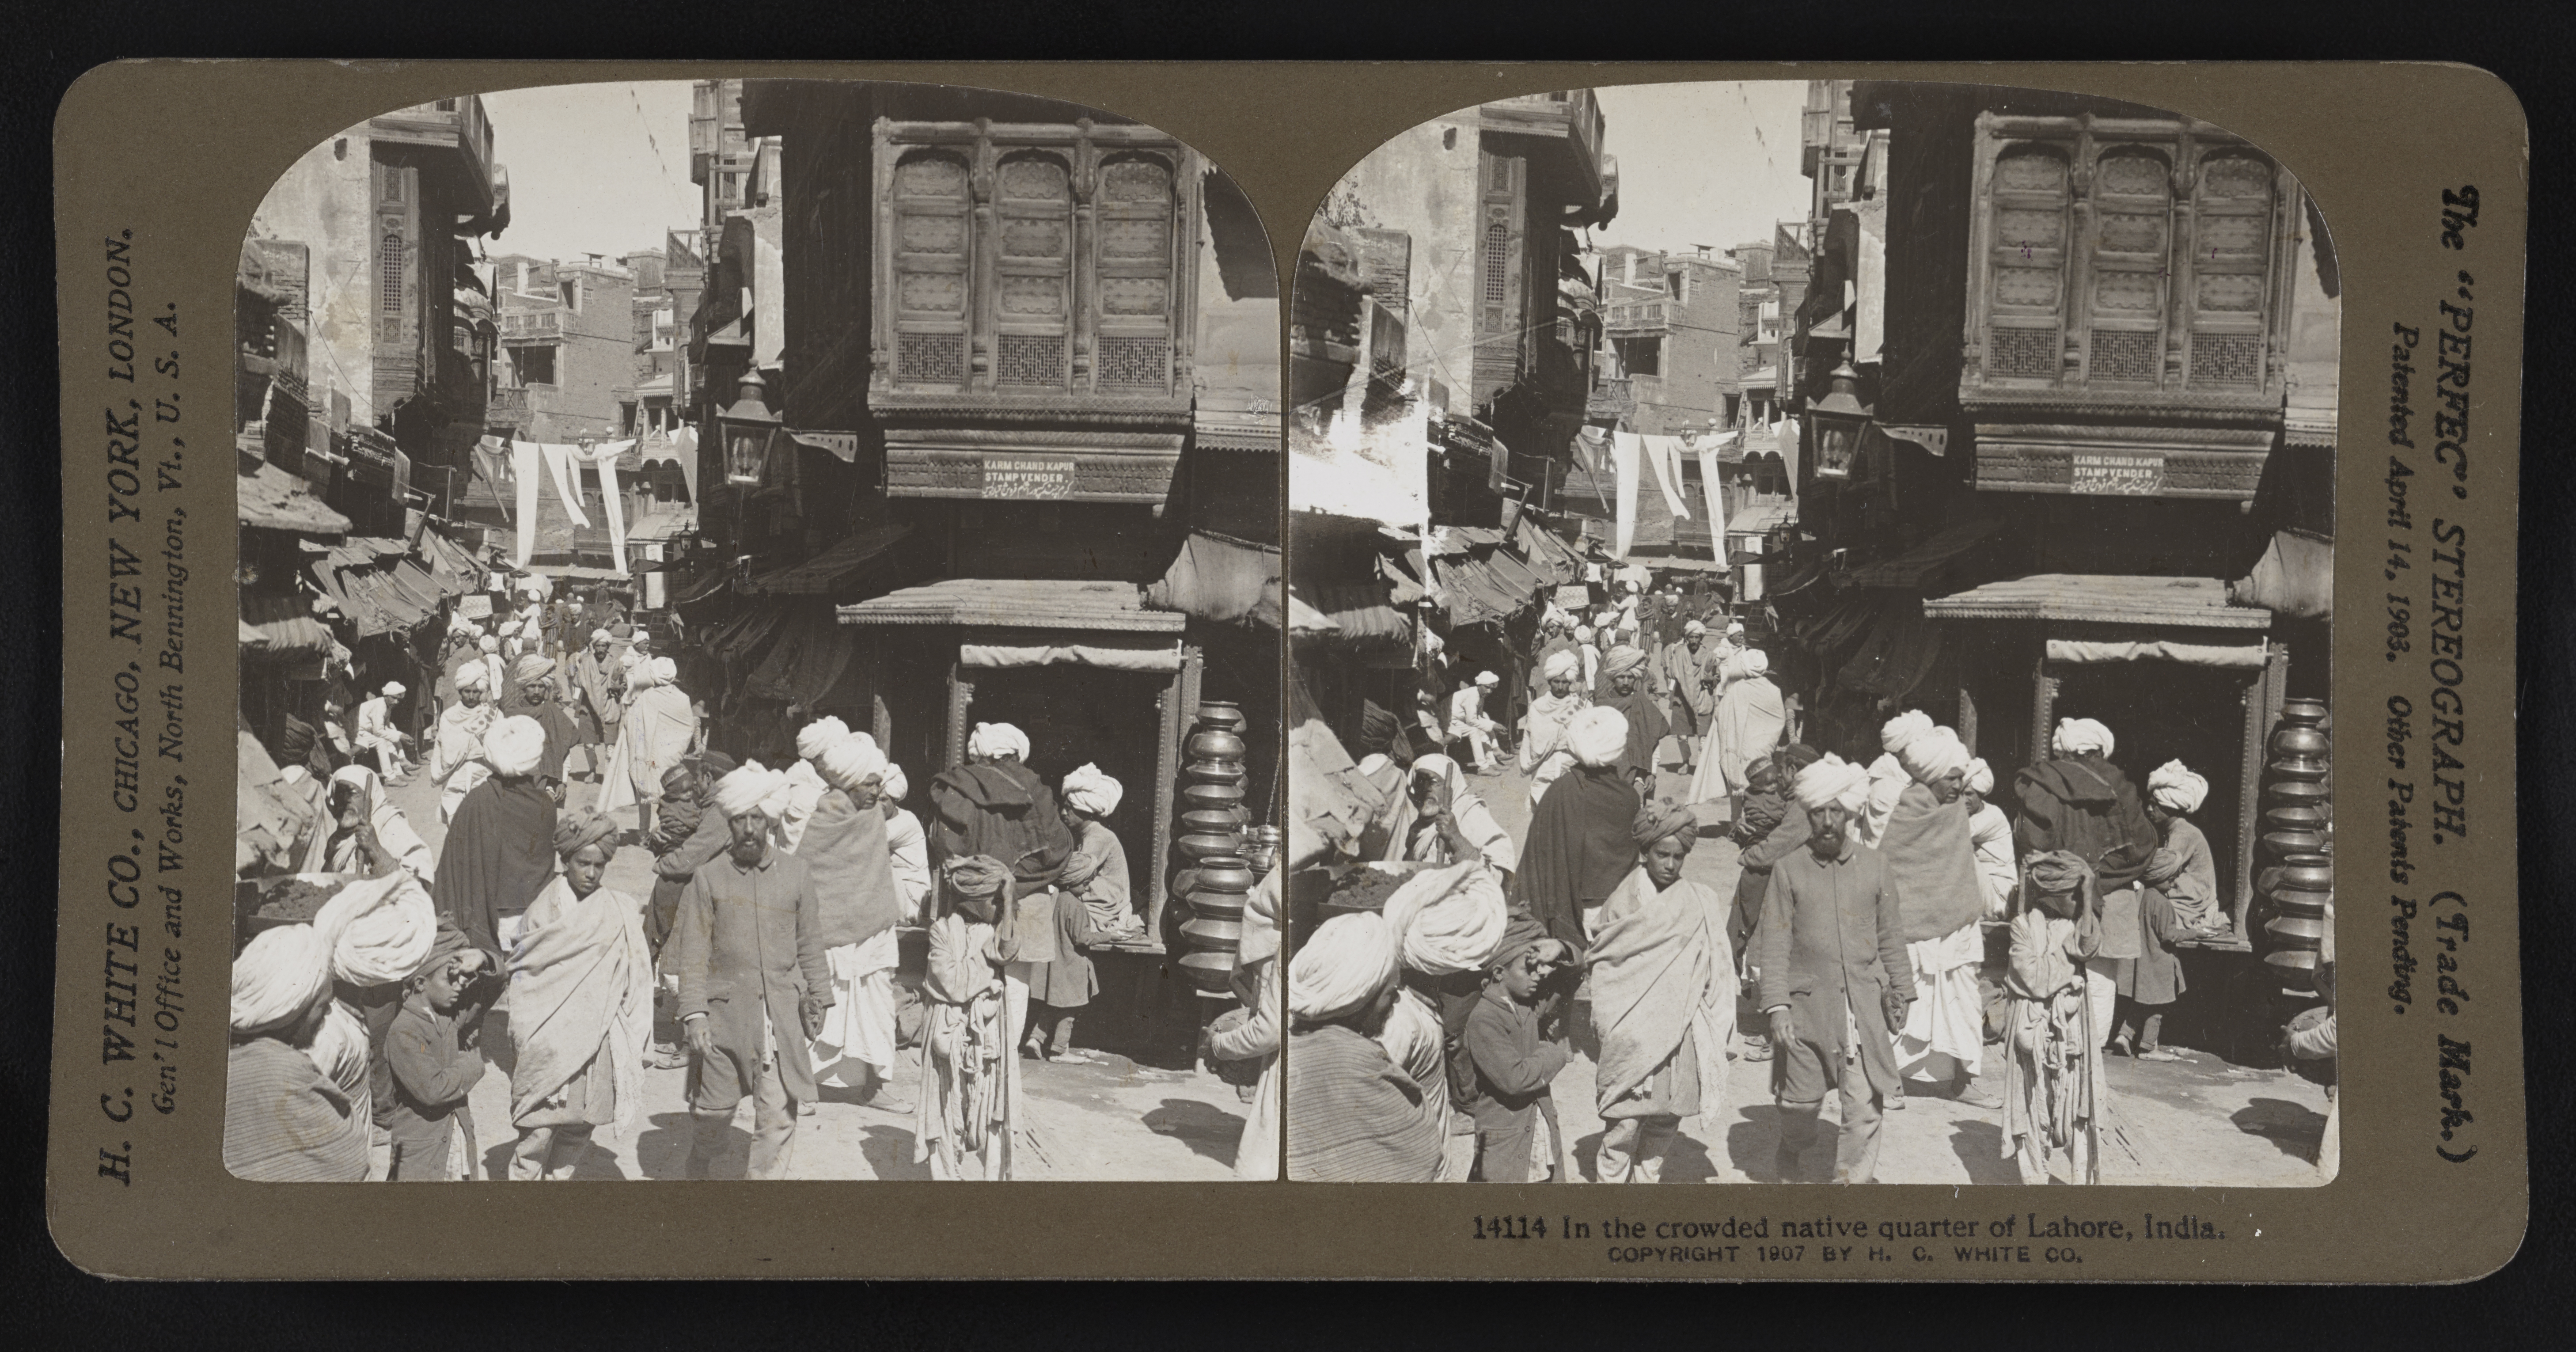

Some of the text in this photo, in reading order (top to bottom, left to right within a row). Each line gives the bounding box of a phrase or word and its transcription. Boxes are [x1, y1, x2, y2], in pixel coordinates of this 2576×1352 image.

[2441, 185, 2480, 250] The
[153, 303, 177, 337] A.
[155, 351, 179, 379] S.
[156, 393, 180, 422] U.
[158, 437, 184, 492] Vt.,
[984, 460, 1074, 471] KARM CHAND KAPUR
[985, 472, 1068, 483] STAMP VENDER.
[2073, 456, 2164, 467] KARM CHAND KAPUR
[2074, 467, 2108, 477] STAMP
[159, 508, 188, 673] Bennington,
[2385, 322, 2419, 1014] Patented April 14, 1903. Other Patents Pending.
[2431, 518, 2466, 844] STEREOGRAPH.
[98, 229, 144, 1186] H. C. WHITE CO., CHICAGO, NEW YORK, LONDON.
[159, 686, 182, 762] North
[159, 775, 187, 873] Works,
[158, 885, 182, 938] and
[2429, 892, 2470, 1015] (Trade
[154, 948, 183, 1031] Office
[2436, 1034, 2477, 1162] Mark.)
[1474, 1214, 2225, 1241] 14114 In the crowded native quarter of Lahore, India.
[1608, 1246, 2083, 1263] COPYRIGHT 1907 BY H. C. WHITE CO.
